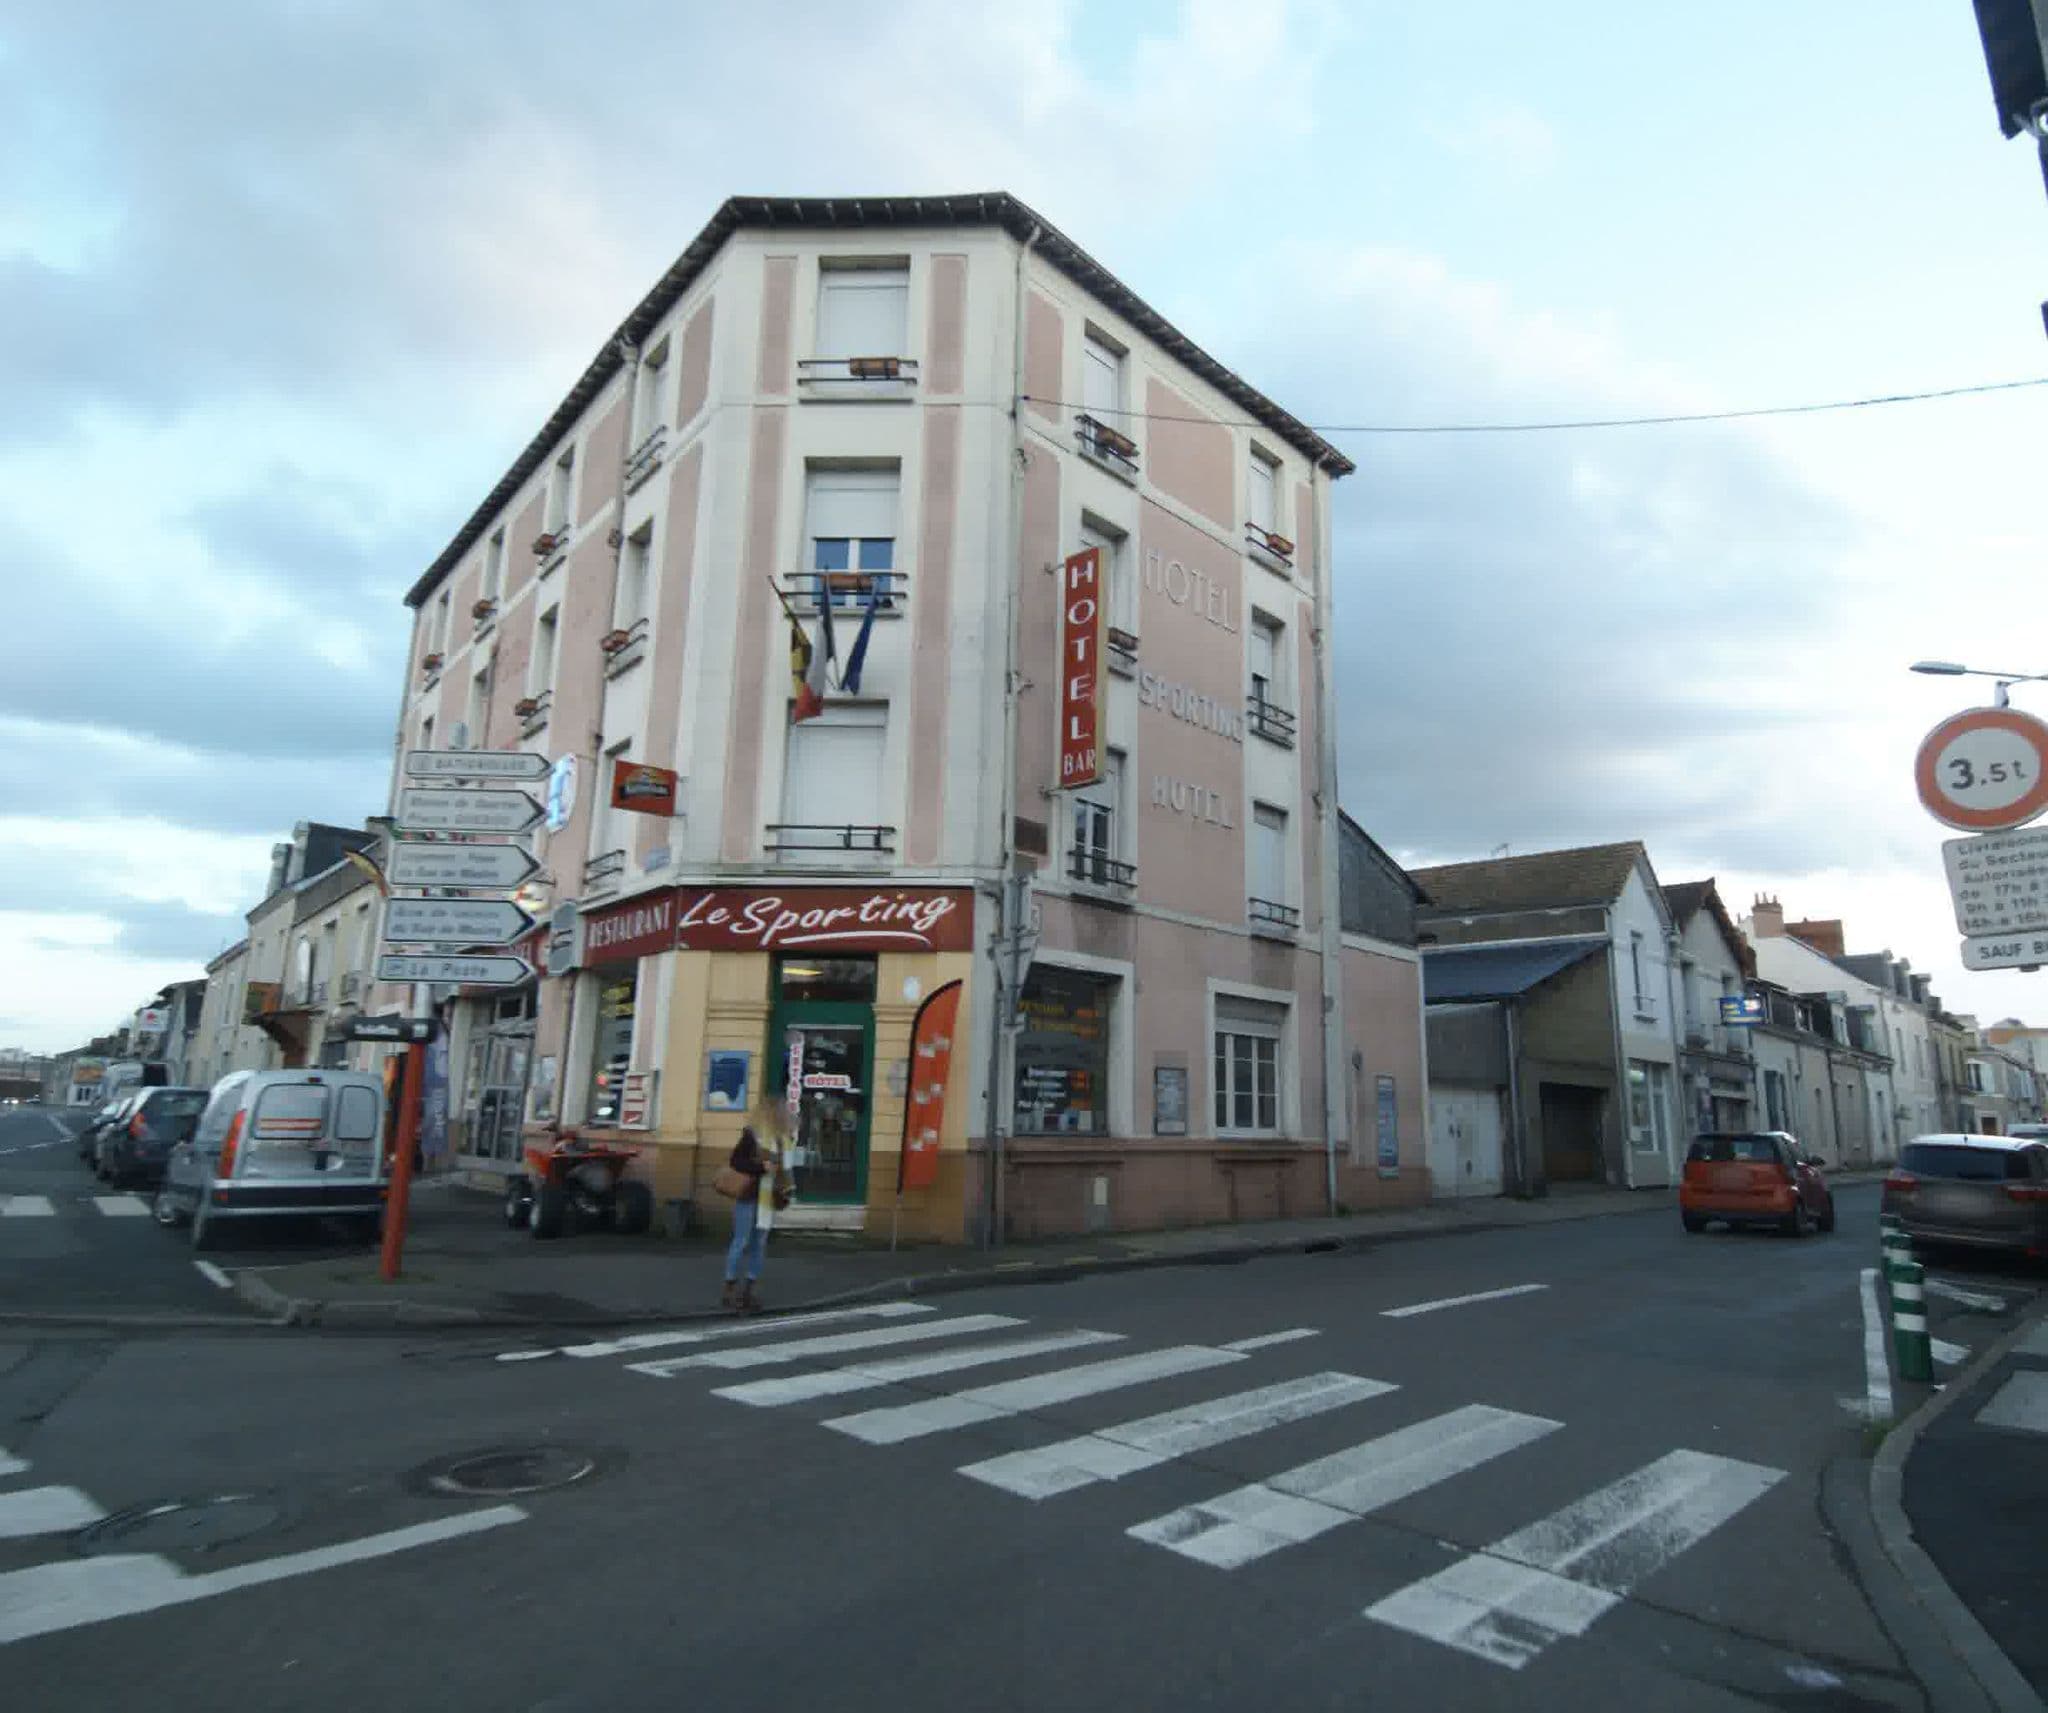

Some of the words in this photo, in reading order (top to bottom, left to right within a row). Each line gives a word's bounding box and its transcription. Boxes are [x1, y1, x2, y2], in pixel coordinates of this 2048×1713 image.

[1067, 559, 1097, 741] HOTEL
[1062, 749, 1097, 777] BAR
[588, 899, 670, 949] RESTAURANT
[679, 892, 730, 929] Le
[729, 893, 957, 946] Sporting
[1978, 942, 2022, 960] SAUF
